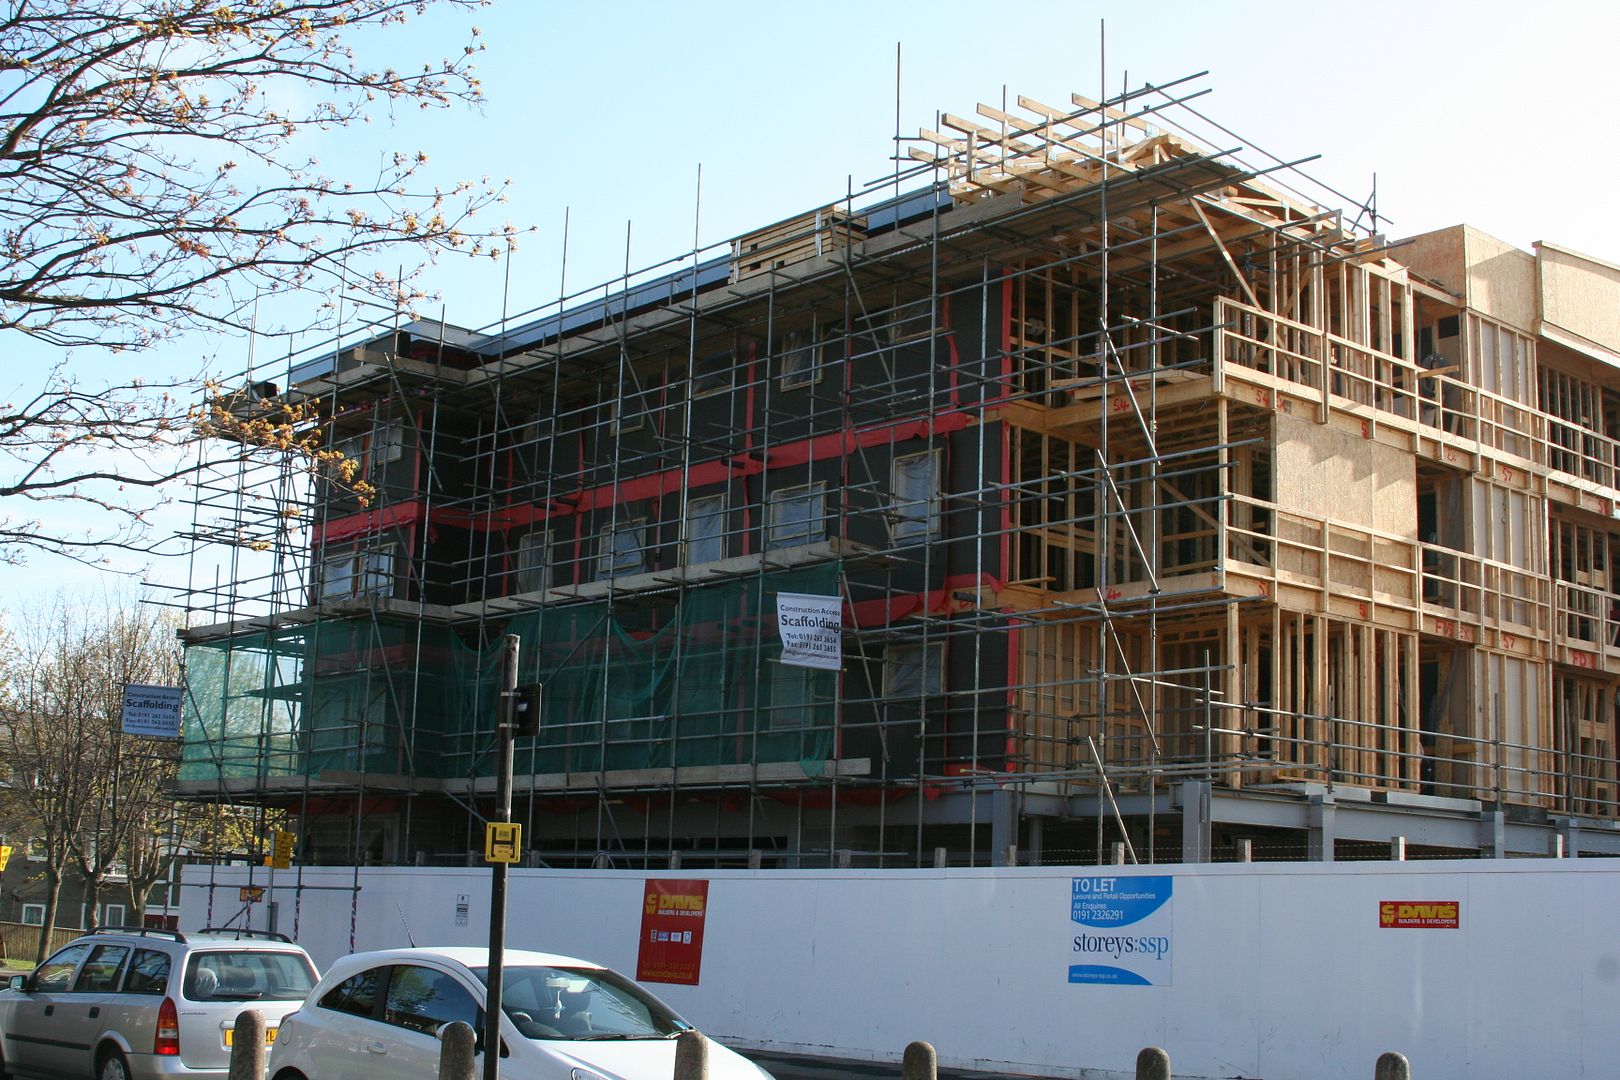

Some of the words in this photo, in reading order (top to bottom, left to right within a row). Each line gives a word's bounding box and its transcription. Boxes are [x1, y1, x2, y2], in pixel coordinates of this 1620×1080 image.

[780, 604, 820, 614] Construction
[821, 608, 840, 616] Access
[781, 614, 839, 633] Scaffolding
[126, 699, 178, 712] Scaffolding
[1074, 879, 1090, 892] TO
[1093, 878, 1117, 892] LET
[1119, 892, 1156, 900] Opportunities
[1073, 910, 1090, 920] 0191
[1091, 910, 1123, 920] 2326291
[1398, 905, 1456, 919] DAVIS
[1073, 933, 1169, 960] storeys:ssp
